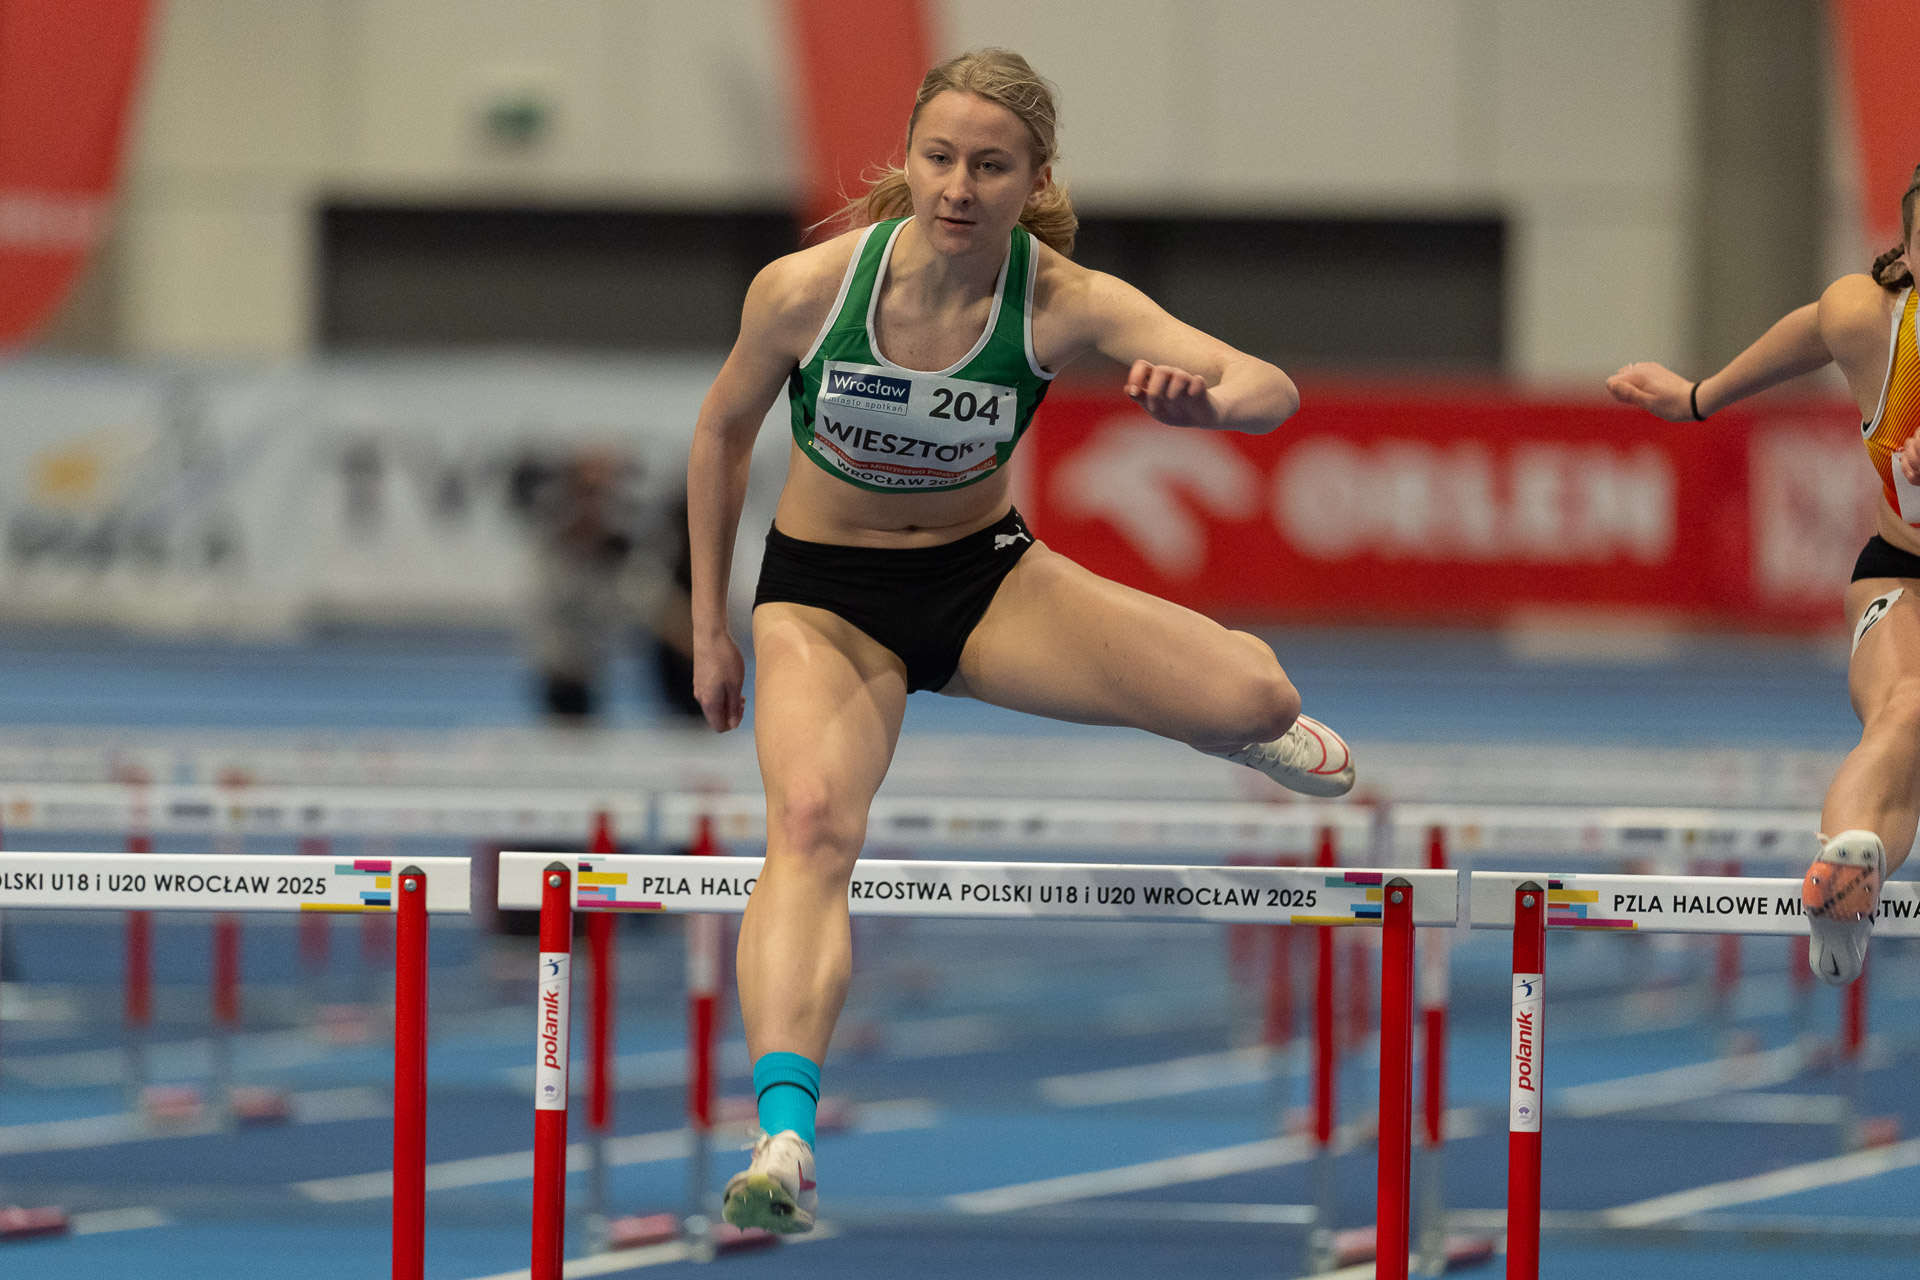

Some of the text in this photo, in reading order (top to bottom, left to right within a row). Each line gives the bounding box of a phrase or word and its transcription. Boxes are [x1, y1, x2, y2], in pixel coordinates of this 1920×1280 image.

[834, 374, 906, 398] Wrocław
[865, 401, 903, 413] spotkań
[929, 388, 999, 426] 204
[837, 456, 925, 487] WROCŁAW
[0, 872, 327, 895] LSKI U18 i U20 WROCŁAW 2025
[642, 876, 1317, 908] PZLA HALO RZOSTWA POLSKI U18 i U20 WROCŁAW 2025
[1613, 895, 1664, 913] PZLA
[1672, 896, 1769, 915] HALOWE
[542, 989, 561, 1071] polanik
[1515, 1010, 1535, 1092] polanik
